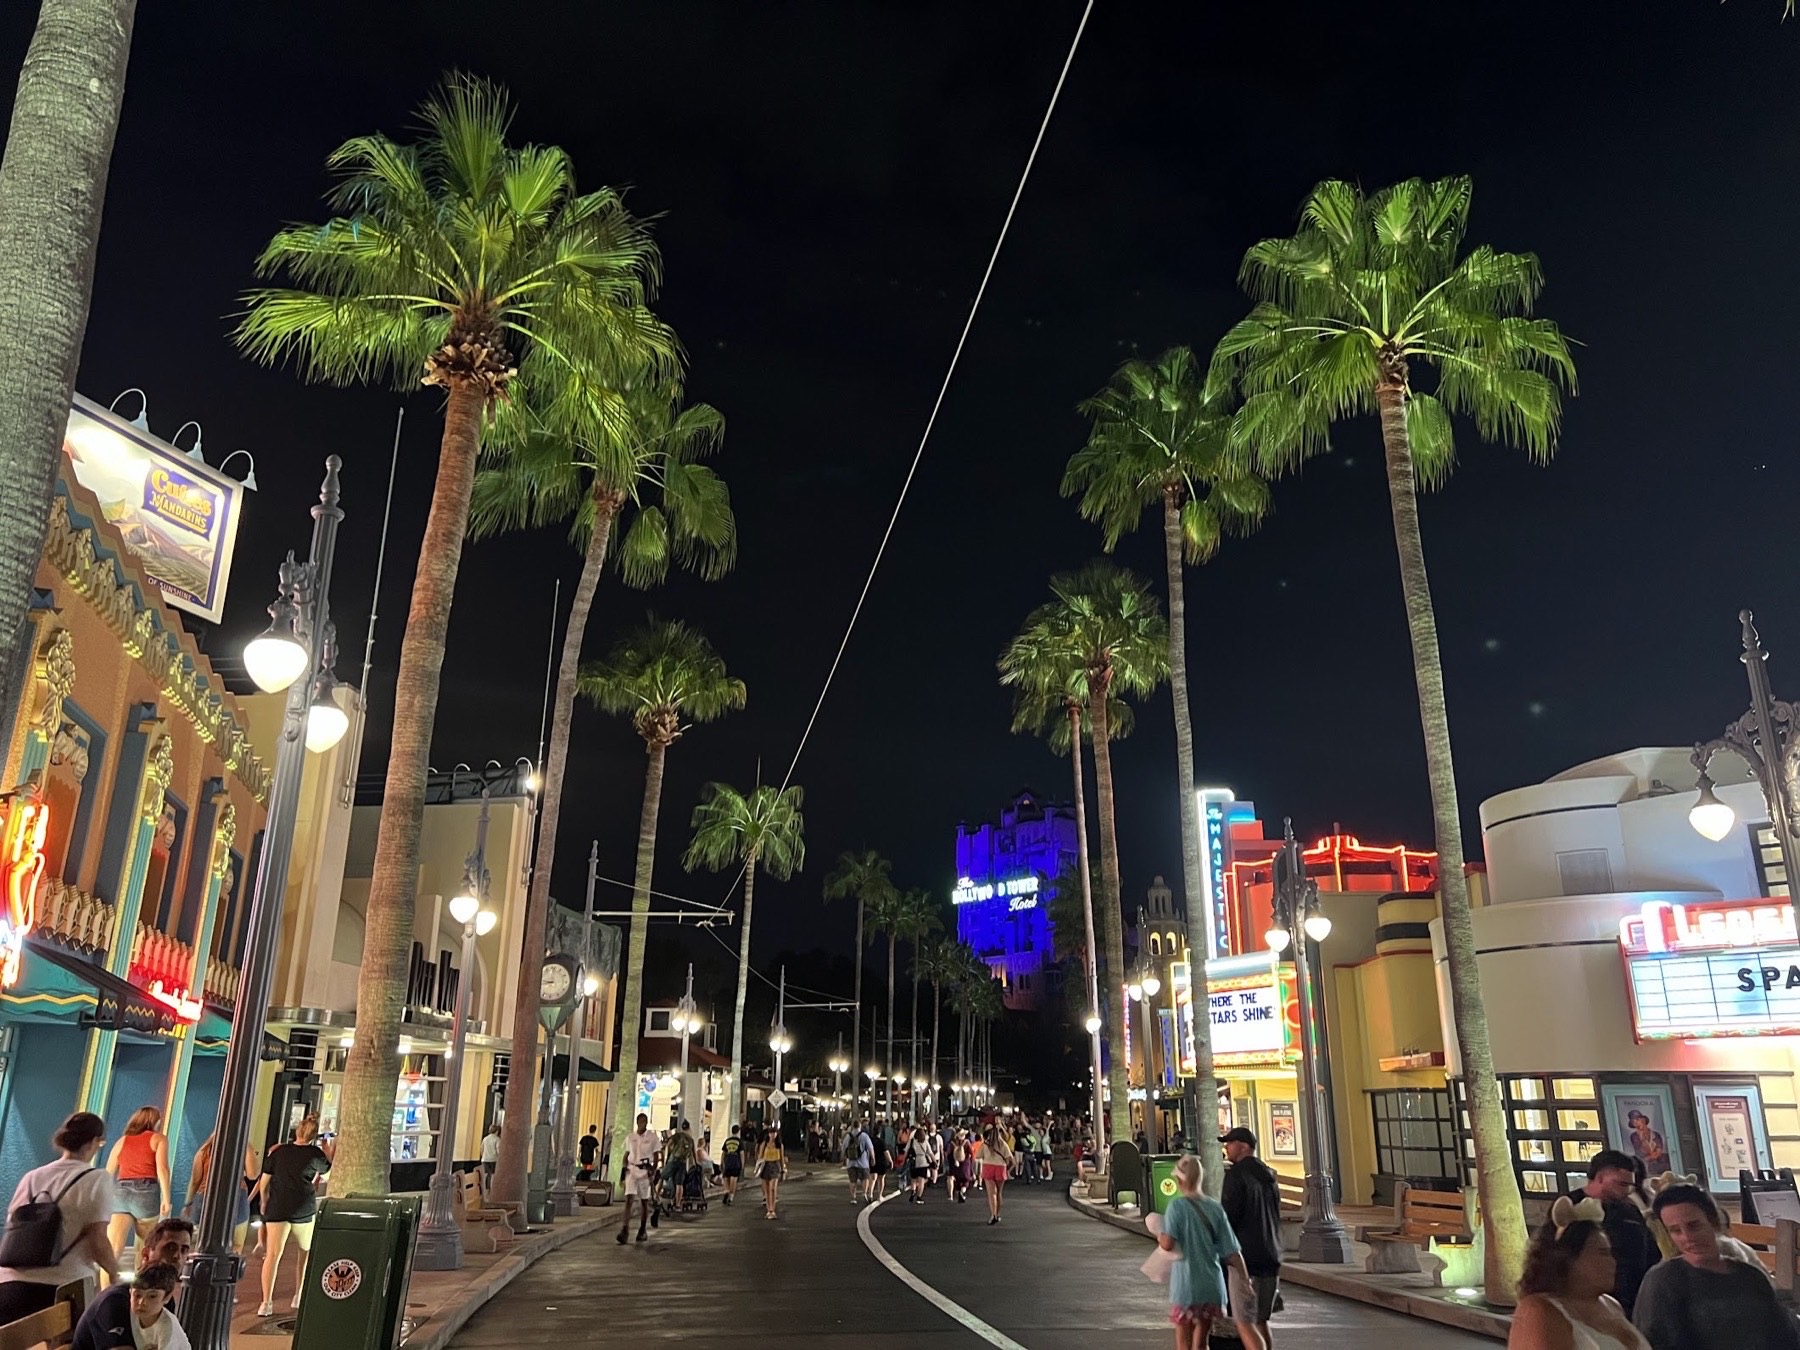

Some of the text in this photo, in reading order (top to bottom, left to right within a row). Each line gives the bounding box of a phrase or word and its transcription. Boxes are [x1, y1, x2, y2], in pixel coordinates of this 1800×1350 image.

[151, 469, 212, 517] Cutes
[149, 491, 207, 529] MANDARINS
[952, 876, 1039, 904] HOLLYWOD TOWER
[1210, 822, 1229, 948] MAJESTIC
[1008, 893, 1038, 912] Hotel
[1208, 992, 1257, 1008] HERE THE
[324, 1262, 339, 1277] PLEASE
